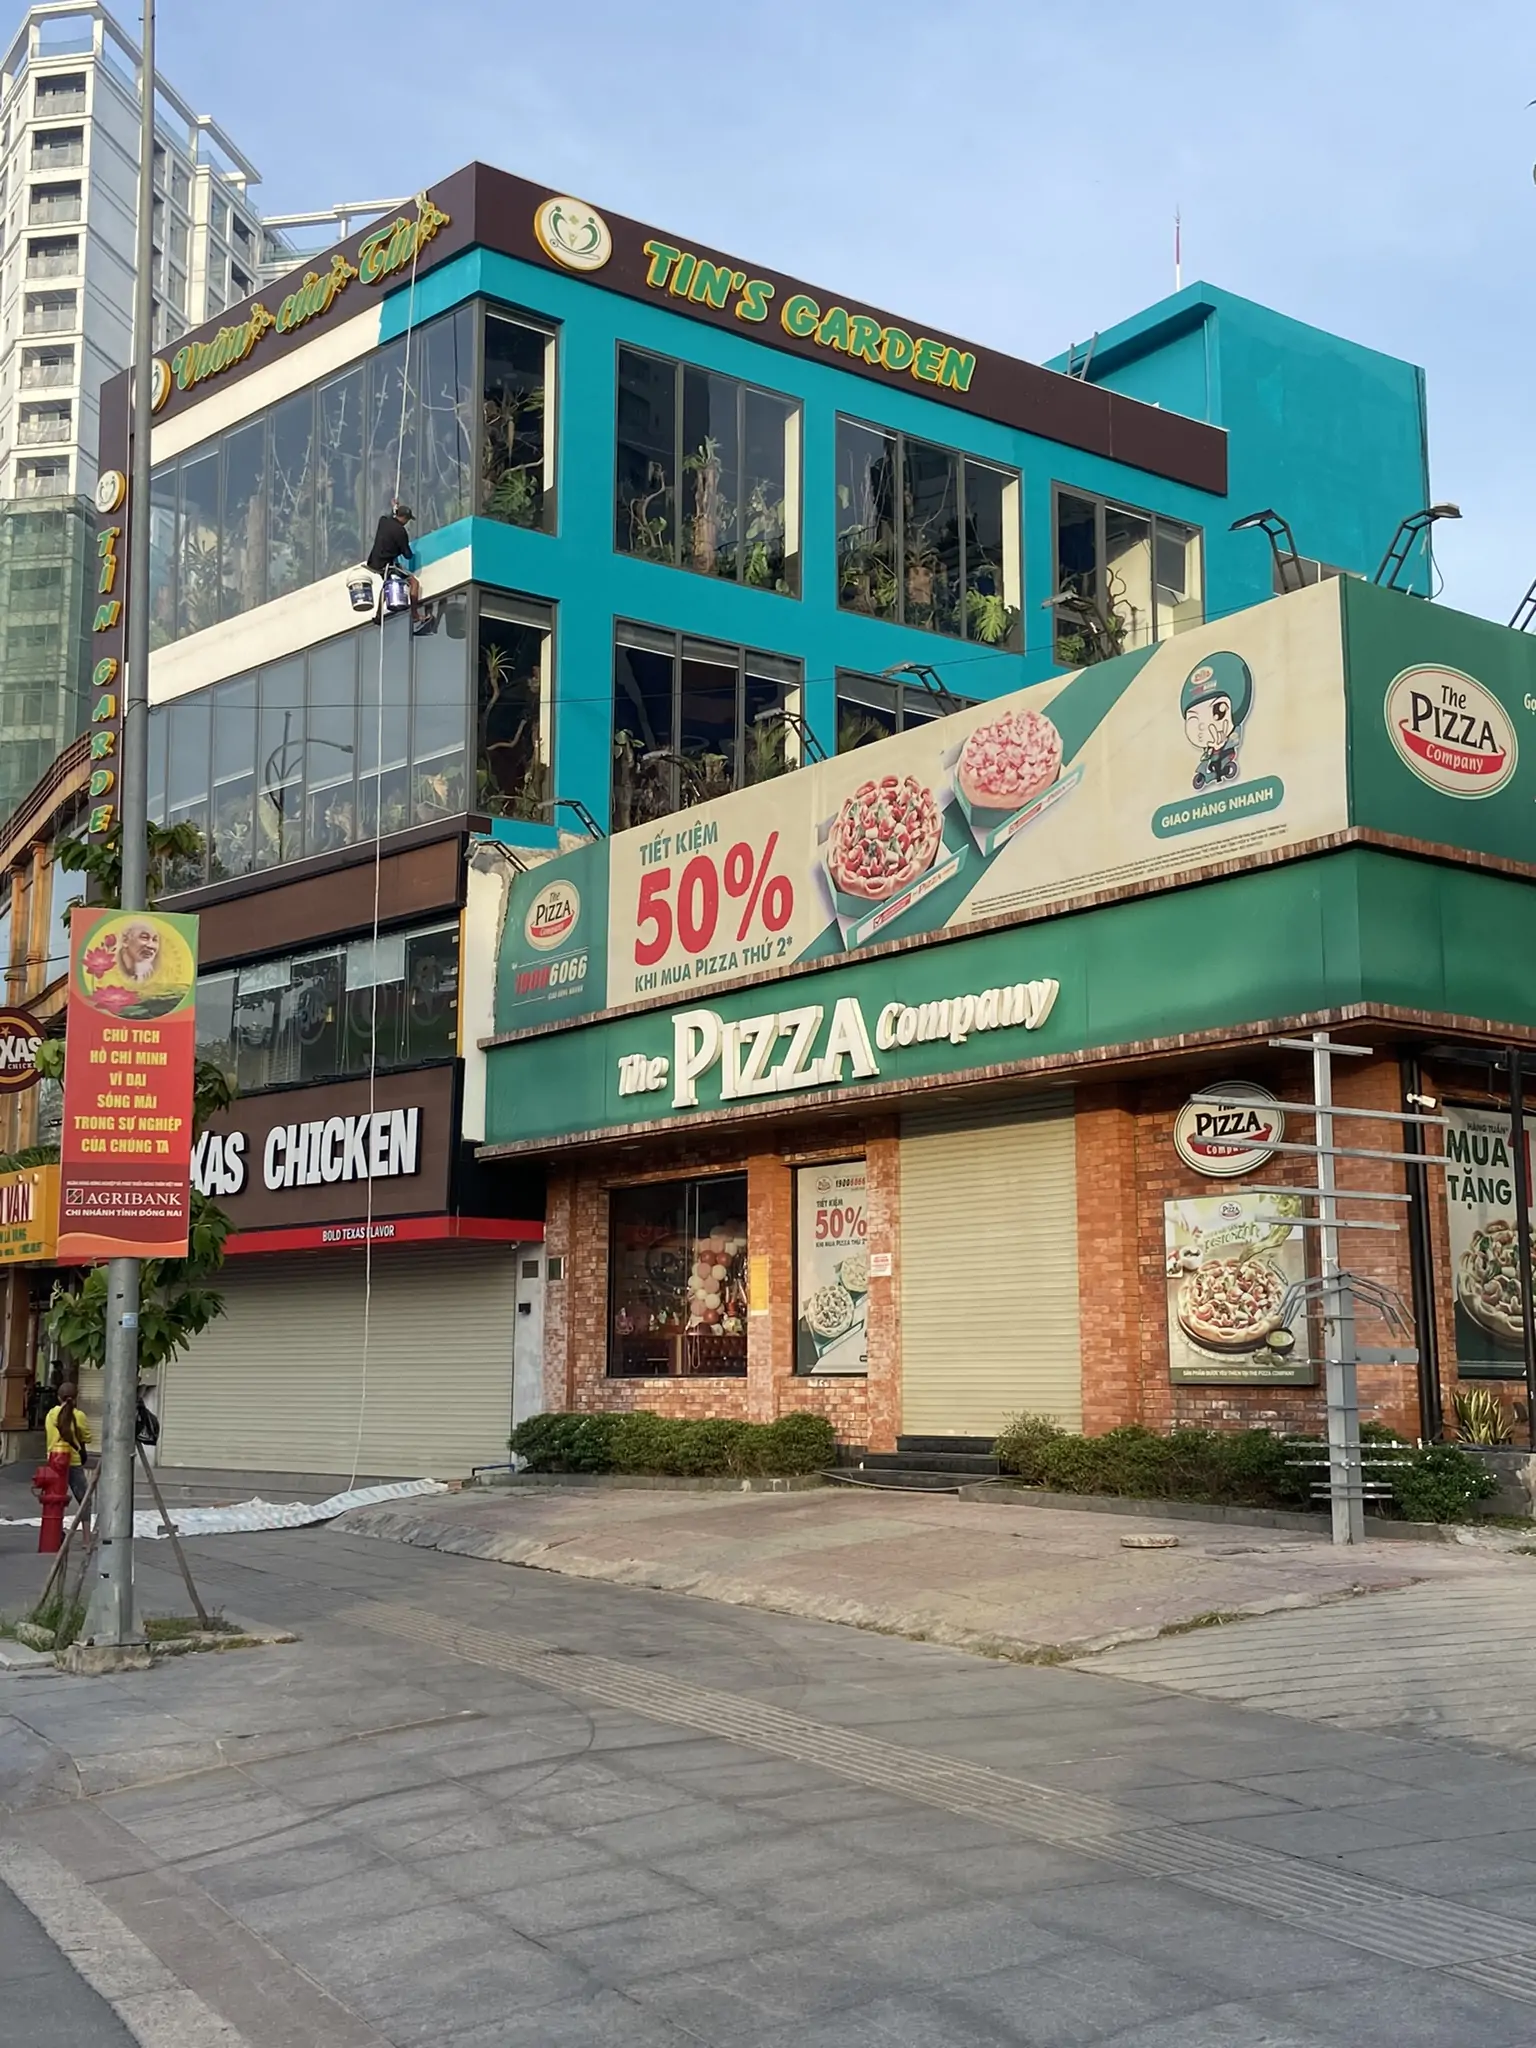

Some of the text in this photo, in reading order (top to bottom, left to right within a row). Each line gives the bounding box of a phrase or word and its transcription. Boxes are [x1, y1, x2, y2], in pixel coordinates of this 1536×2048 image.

[644, 240, 976, 392] TIN'S GARDEN
[1441, 684, 1466, 710] The
[1410, 690, 1498, 753] PIZZA
[88, 657, 118, 840] GARDE
[1426, 743, 1483, 773] Company
[1161, 787, 1273, 828] GIAO HÀNG NHANH
[639, 820, 718, 866] TIẾT KIỆM
[536, 899, 571, 926] PIZZA
[635, 831, 794, 966] 50%
[635, 971, 657, 993] KHI
[660, 963, 691, 988] MUA
[696, 952, 738, 978] PIZZA
[743, 936, 773, 966] THỨ
[132, 1028, 160, 1046] TỊCH
[618, 1053, 669, 1097] The
[671, 997, 880, 1109] PIZZA
[136, 1051, 168, 1066] MINH
[126, 1073, 147, 1089] ĐẠI
[74, 1115, 182, 1133] TRONG SỰ NGHIỆP
[1195, 1110, 1262, 1137] PIZZA
[156, 1139, 169, 1154] TA
[263, 1107, 420, 1191] CHICKEN
[1446, 1129, 1509, 1168] MUA
[86, 1192, 182, 1206] AGRIBANK
[1447, 1167, 1512, 1210] TẶNG
[65, 1208, 81, 1217] CHI
[82, 1208, 115, 1217] NHÁNH
[166, 1209, 182, 1217] NAI
[815, 1206, 867, 1240] 50%
[322, 1229, 342, 1242] BOLD
[342, 1227, 366, 1240] TEXAS
